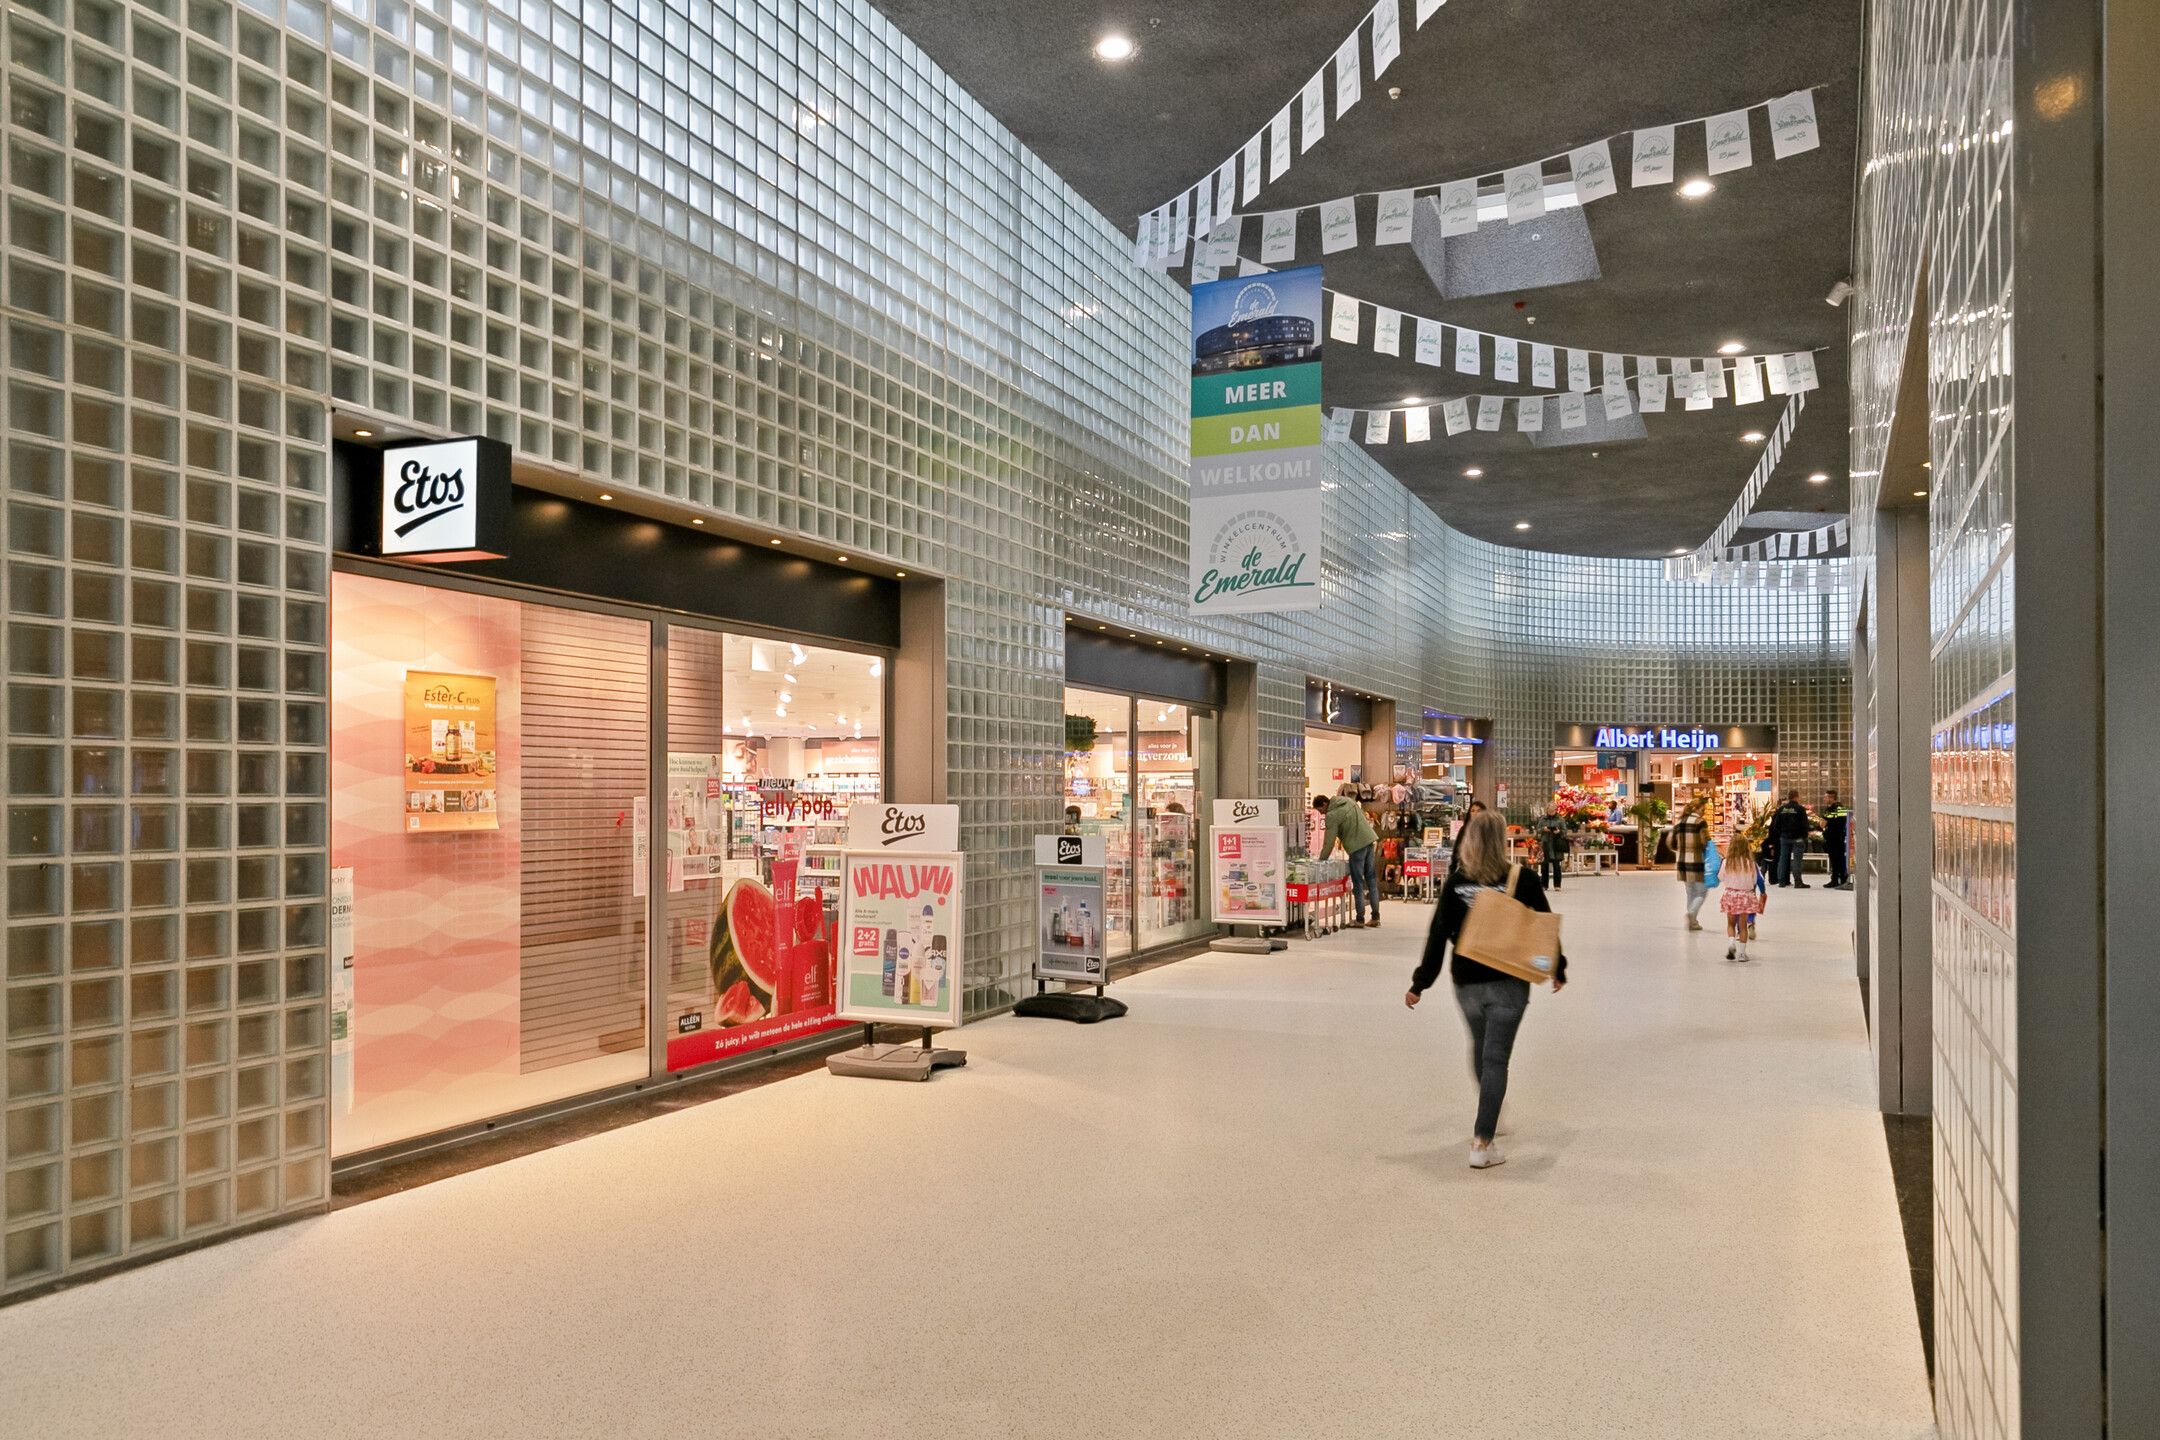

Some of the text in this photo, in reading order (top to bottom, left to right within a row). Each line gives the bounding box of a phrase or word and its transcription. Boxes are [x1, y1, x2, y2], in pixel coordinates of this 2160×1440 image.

[1228, 300, 1278, 328] Emerald
[1225, 380, 1287, 405] MEER
[1230, 422, 1280, 445] DAN
[1200, 459, 1312, 487] WELKOM!
[394, 459, 465, 514] Etos
[1219, 523, 1287, 563] WINKELCENTRUM
[1241, 546, 1262, 571] de
[1194, 553, 1307, 604] Emerald
[424, 688, 465, 703] Ester-C
[1595, 728, 1719, 752] Albert Heijn
[761, 778, 793, 789] nieuw
[760, 792, 796, 826] jelly
[881, 807, 925, 834] Etos
[1233, 801, 1259, 817] Etos
[1059, 840, 1081, 855] Etos
[1223, 836, 1237, 846] 1+1
[1405, 865, 1428, 873] ACTIE
[853, 863, 954, 906] WAUW!
[858, 929, 876, 941] 2+2
[783, 1023, 790, 1032] de
